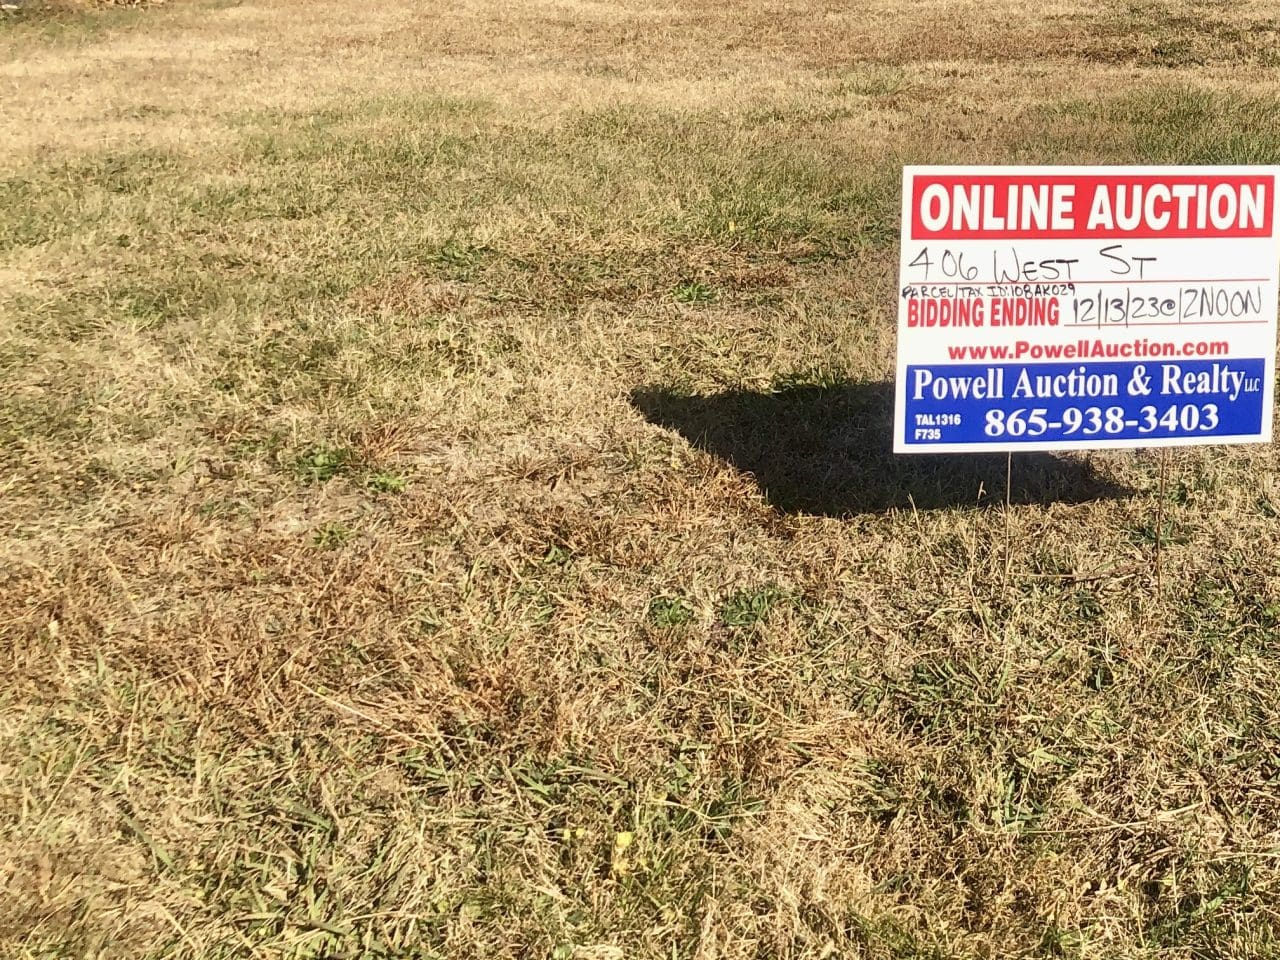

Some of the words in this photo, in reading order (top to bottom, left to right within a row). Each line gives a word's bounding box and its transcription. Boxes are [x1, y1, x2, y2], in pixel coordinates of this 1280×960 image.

[919, 183, 1077, 231] ONLINE
[1086, 183, 1266, 230] AUCTION
[908, 246, 979, 281] 406
[907, 297, 985, 328] BIDDING
[990, 296, 1060, 327] ENDING
[948, 338, 1229, 360] www.PowellAuction.com
[912, 367, 1004, 400] Powell
[1011, 365, 1119, 399] Auction
[1126, 364, 1153, 396] &
[1160, 363, 1246, 402] Realty
[1244, 377, 1261, 393] LLC
[914, 428, 942, 440] F735
[915, 413, 962, 426] TAL1316
[984, 402, 1220, 437] 865-938-3403
